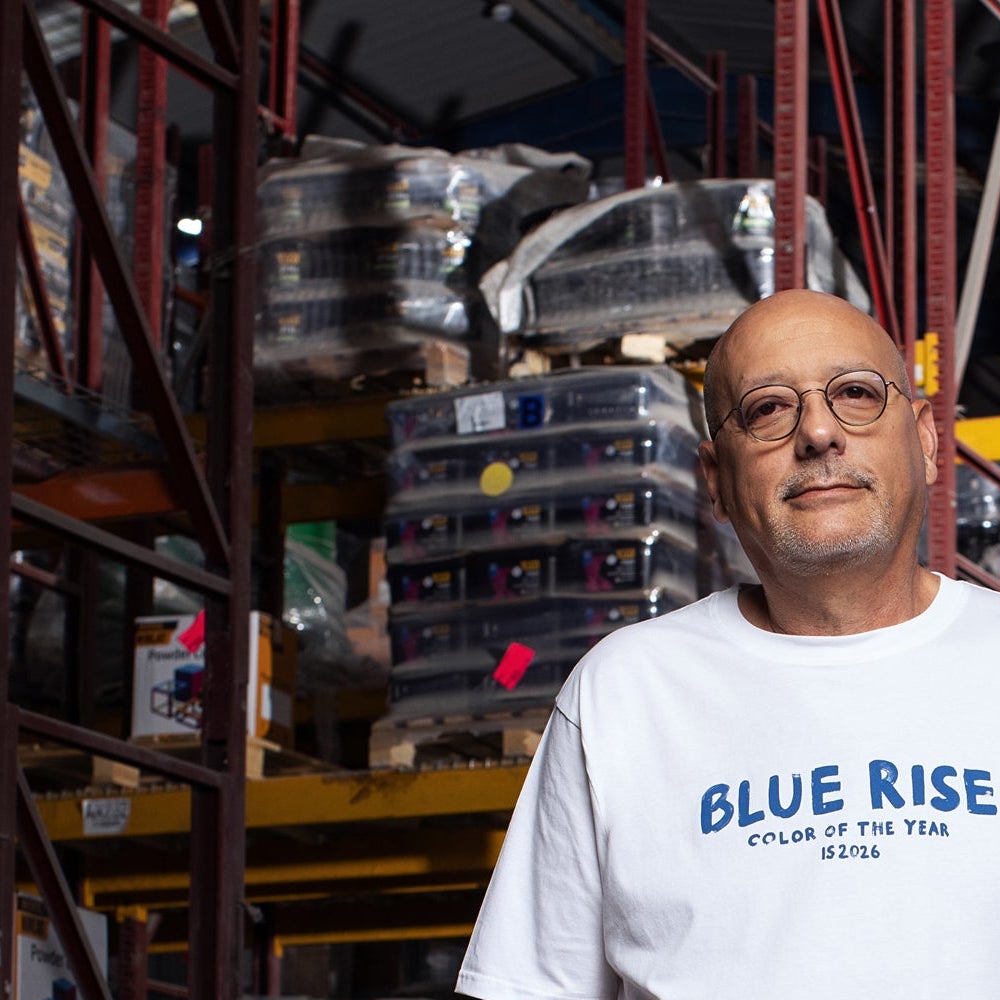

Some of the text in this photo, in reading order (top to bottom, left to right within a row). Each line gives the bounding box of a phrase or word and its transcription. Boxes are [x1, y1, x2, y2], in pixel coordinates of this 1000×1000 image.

[700, 758, 999, 835] BLUE RISE
[747, 818, 950, 848] COLOR OF THE YEAR
